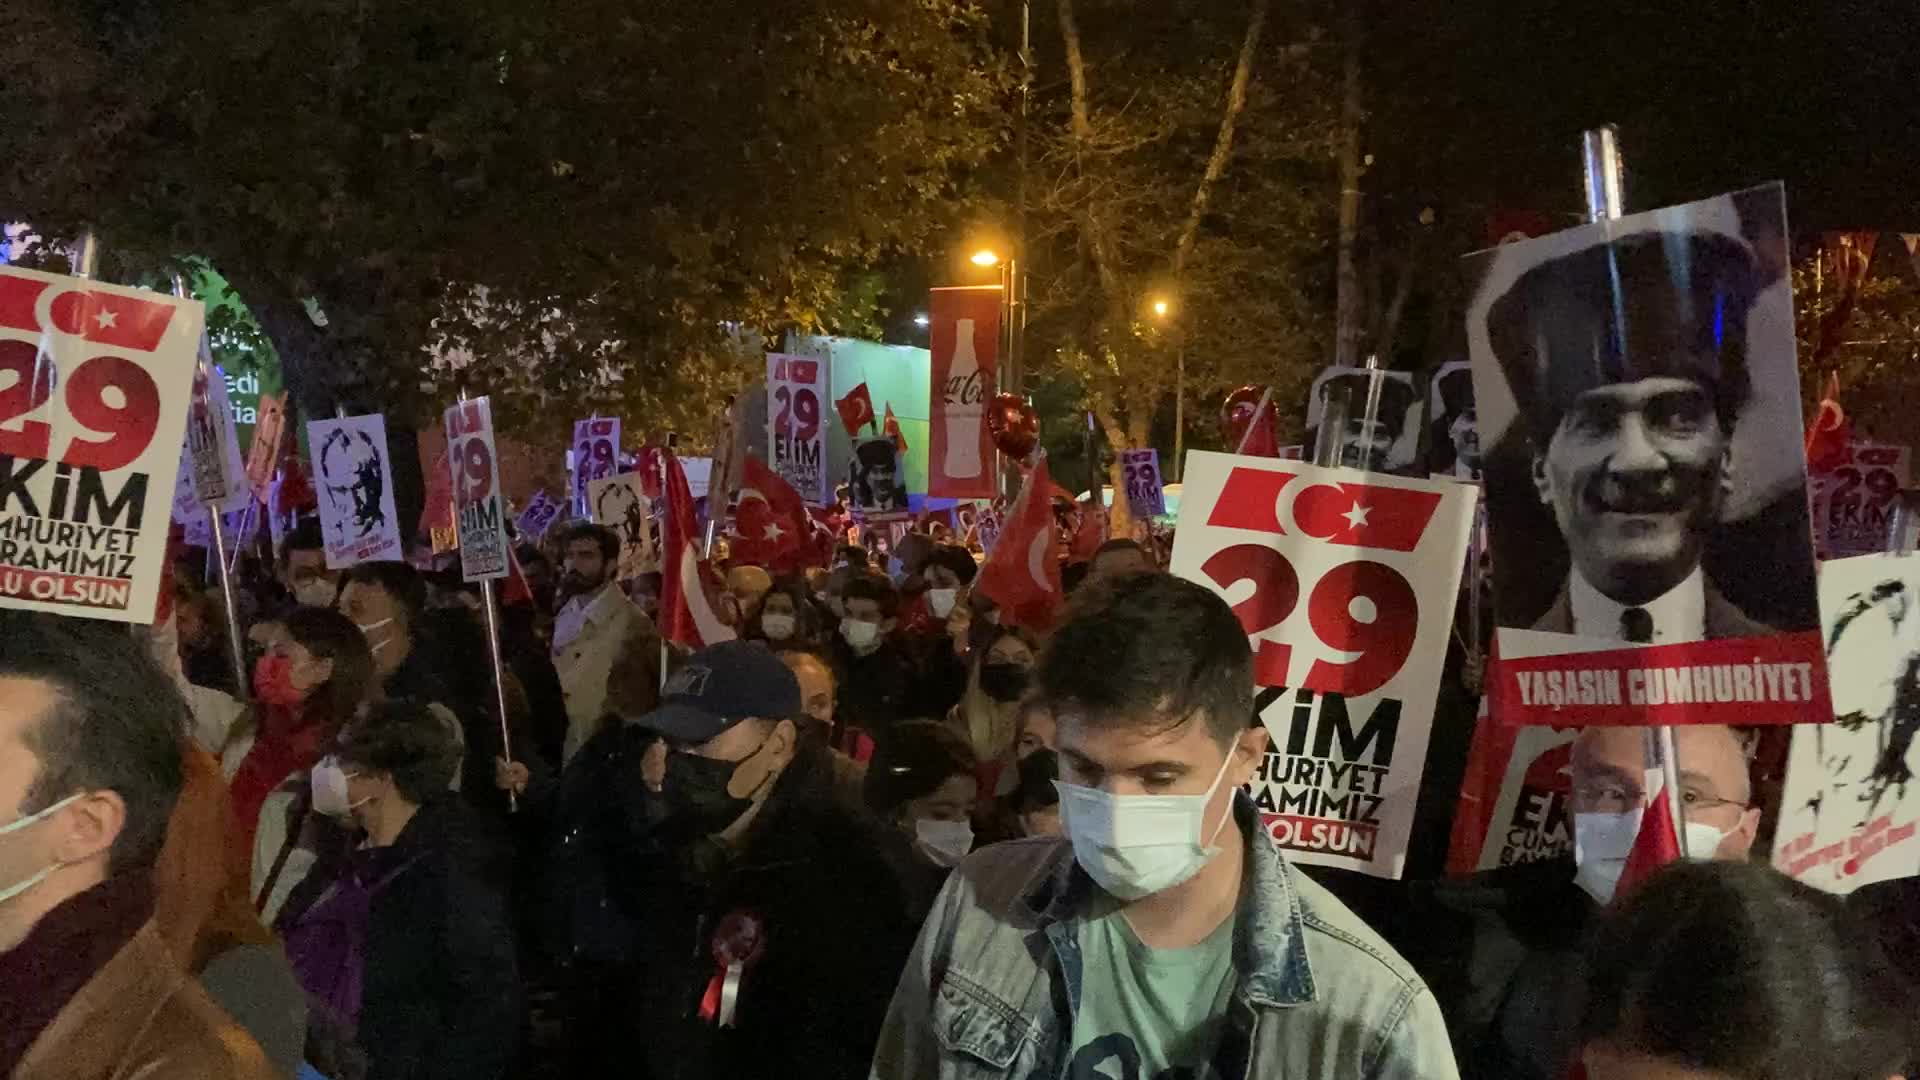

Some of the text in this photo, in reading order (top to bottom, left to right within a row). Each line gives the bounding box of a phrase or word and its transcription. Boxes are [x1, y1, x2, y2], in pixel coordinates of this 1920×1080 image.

[775, 385, 819, 442] 29
[30, 576, 127, 605] OLSUN
[1516, 656, 1811, 711] YAŞASIN CUMHURİYET
[1268, 819, 1373, 858] OLSUN
